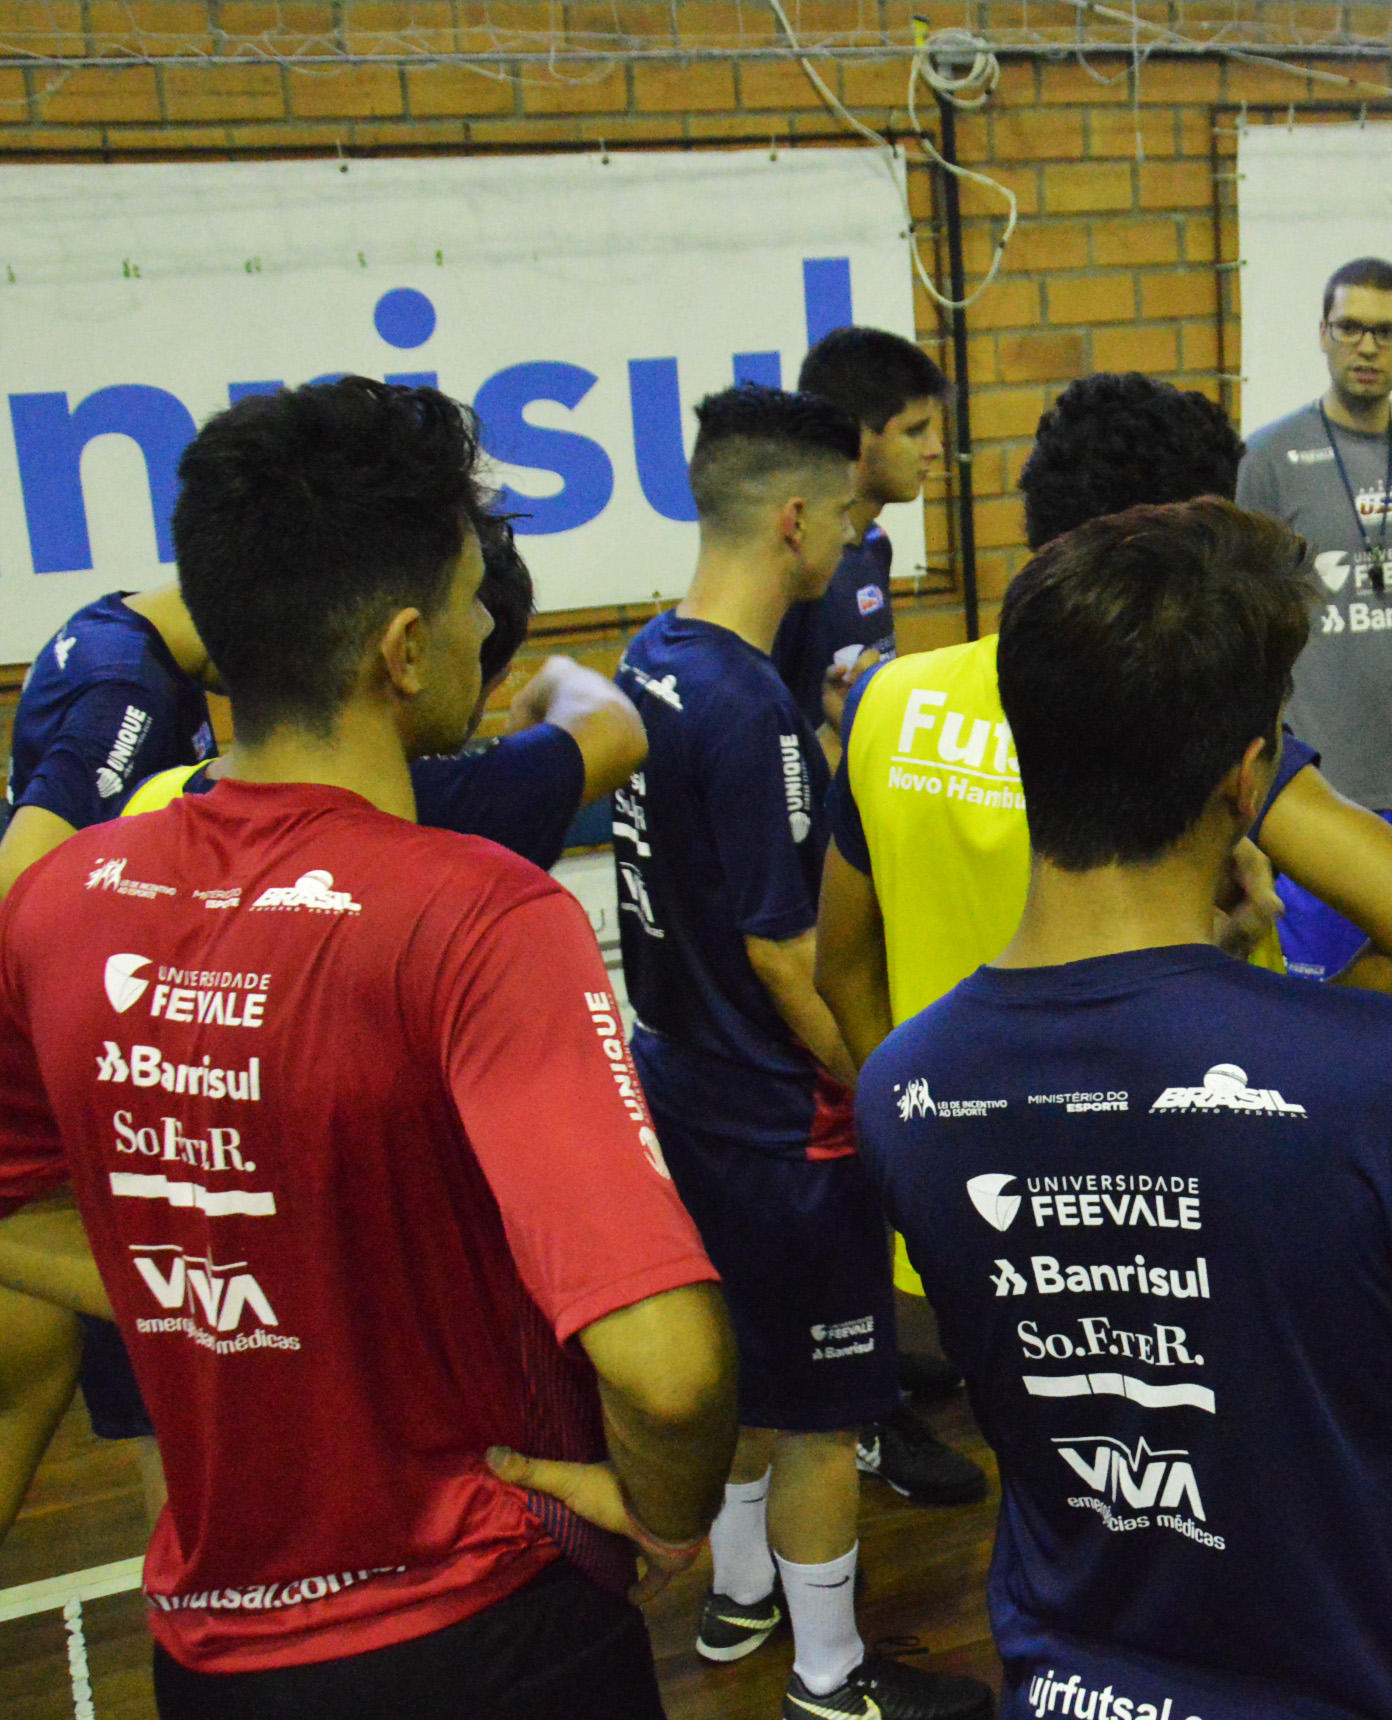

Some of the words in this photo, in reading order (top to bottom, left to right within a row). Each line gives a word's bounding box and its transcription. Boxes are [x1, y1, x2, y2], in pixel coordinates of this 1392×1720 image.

[106, 704, 147, 773] UNIQUE
[897, 687, 1021, 774] Fut
[779, 733, 804, 812] UNIQUE
[887, 765, 943, 795] Novo
[584, 991, 644, 1122] UNIQUE
[952, 1108, 988, 1117] ESPORTE
[1027, 1091, 1104, 1105] MINISTÉRIO
[1106, 1090, 1129, 1101] DO
[1066, 1101, 1129, 1113] ESPORTE
[1152, 1087, 1307, 1113] BRASIL
[1026, 1174, 1200, 1194] UNIVERSIDADE
[1031, 1194, 1202, 1230] FEEVALE
[1030, 1254, 1211, 1299] Banrisul
[216, 1328, 301, 1354] médicas
[1057, 1446, 1207, 1522] VIVA
[1156, 1513, 1226, 1551] médicas
